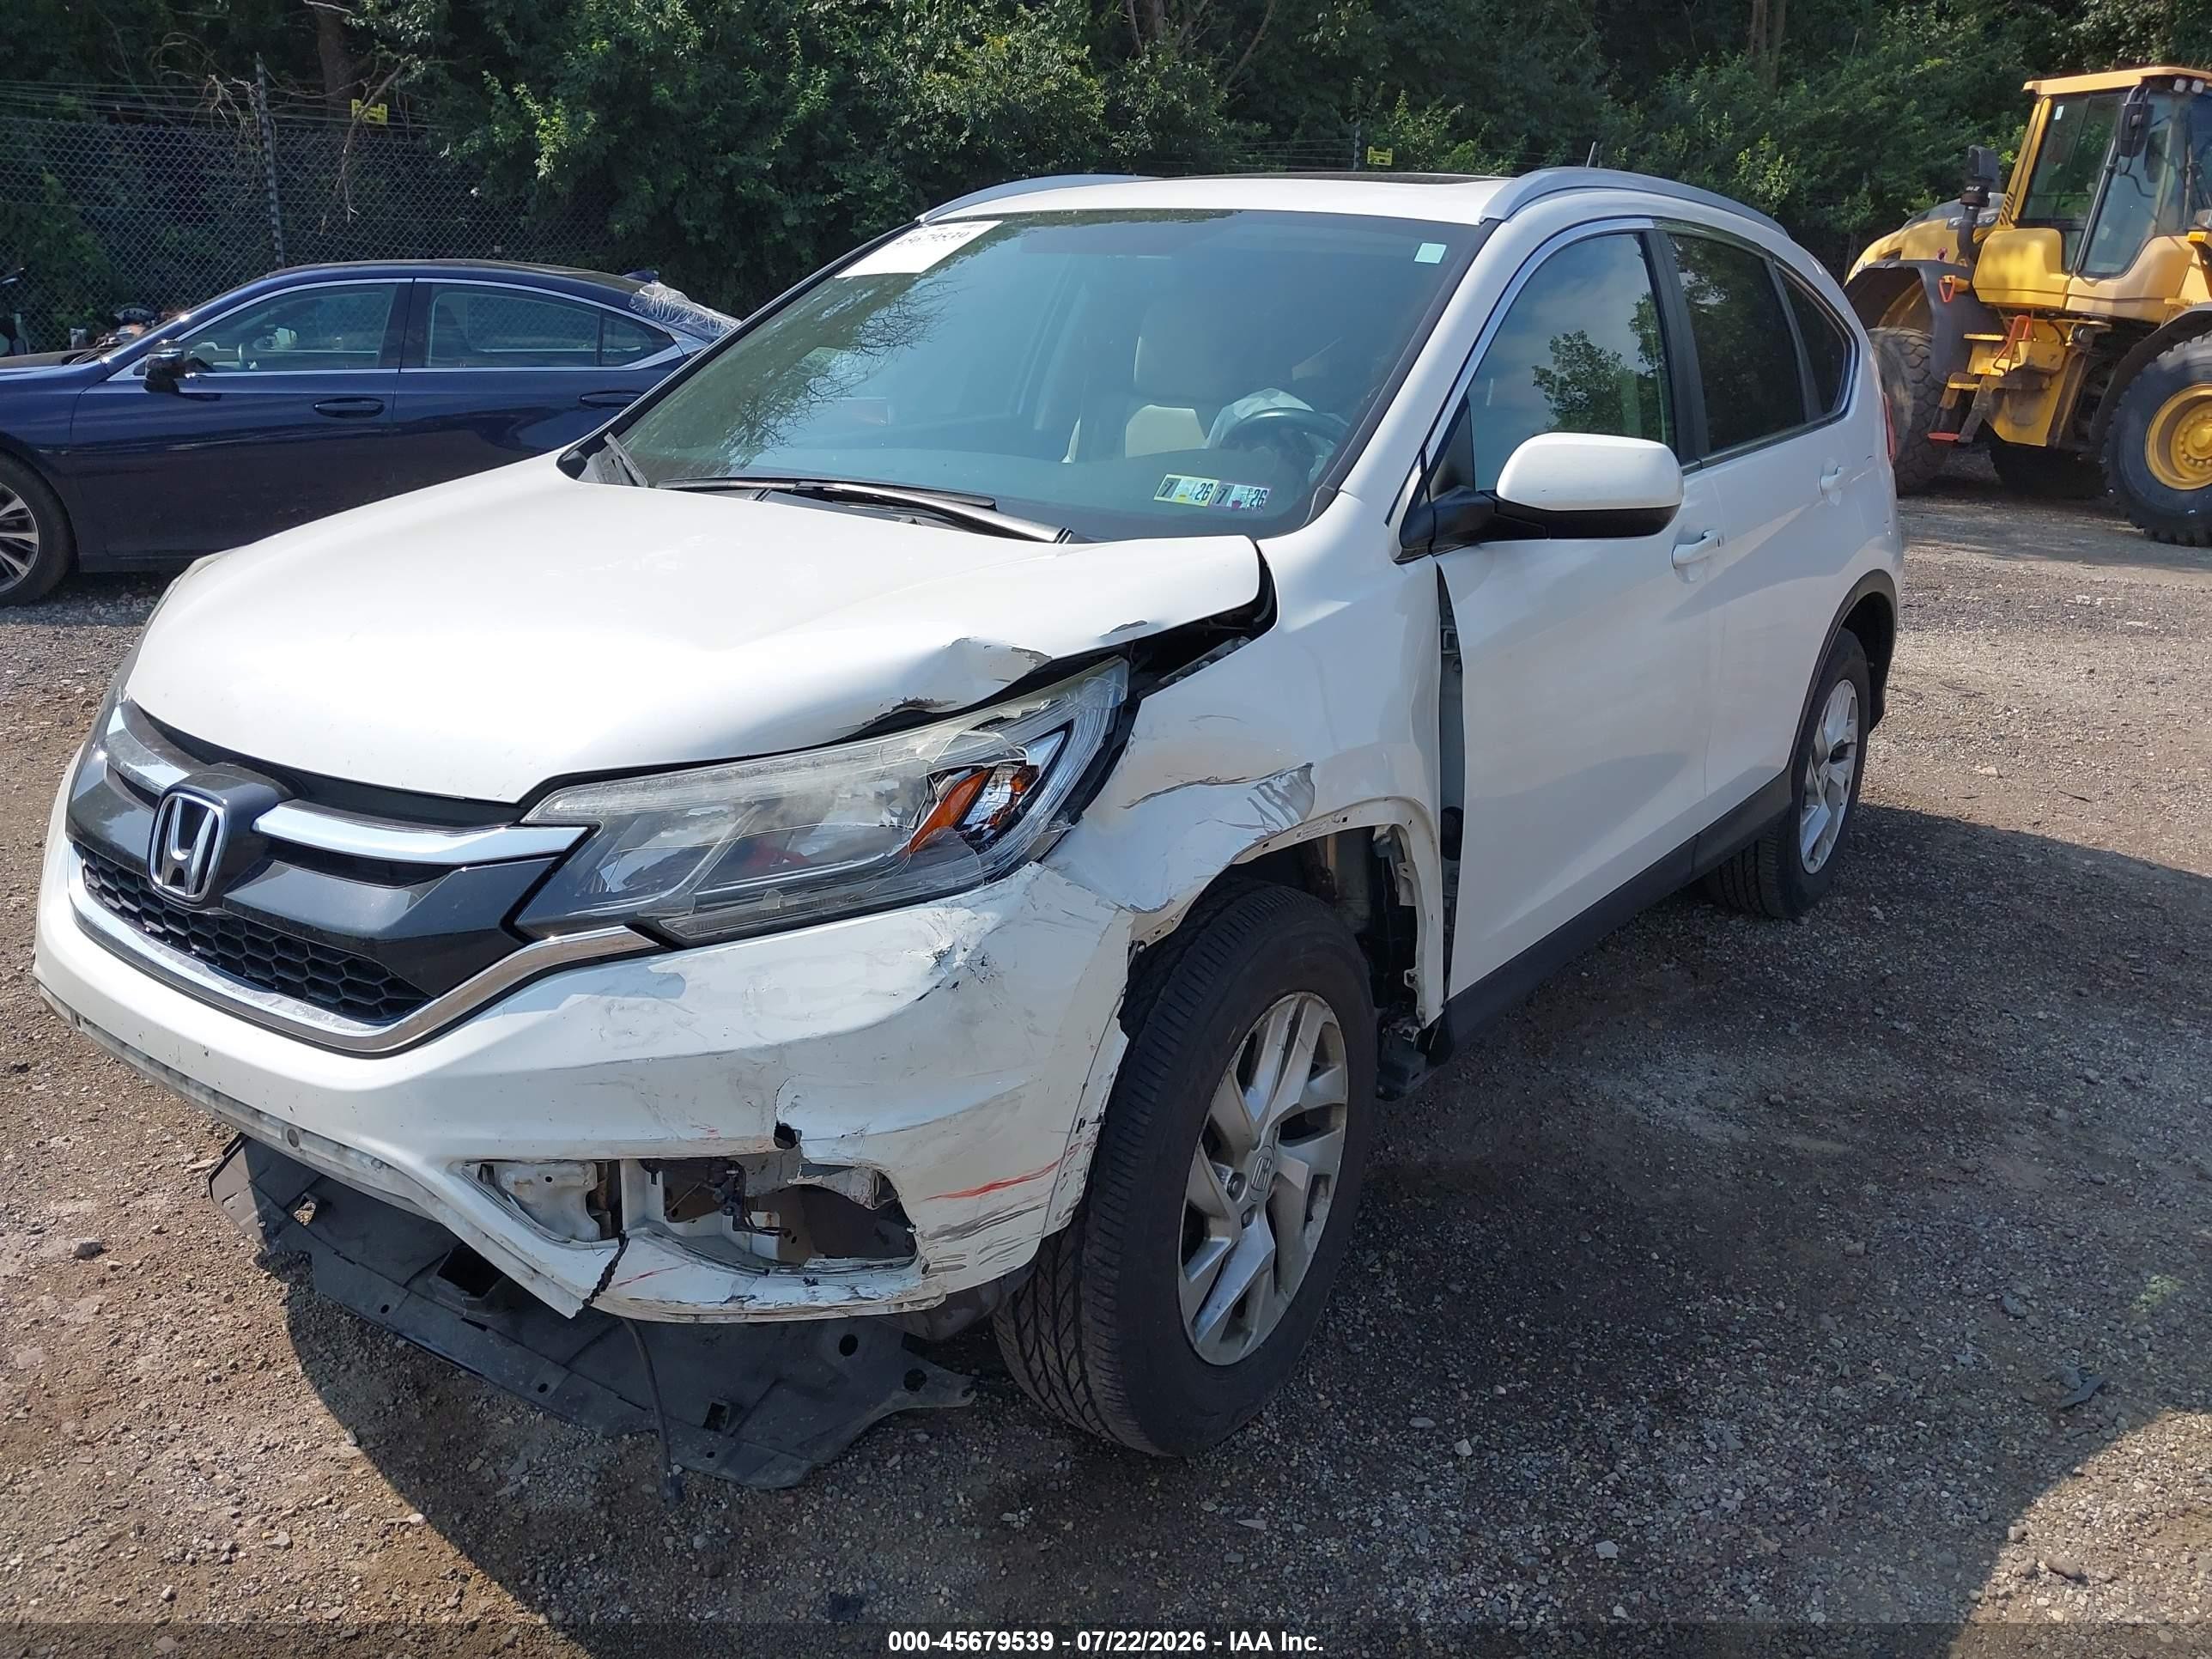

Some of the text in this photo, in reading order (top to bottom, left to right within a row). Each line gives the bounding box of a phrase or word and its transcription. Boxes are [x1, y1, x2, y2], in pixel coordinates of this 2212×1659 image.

[1161, 482, 1213, 501] 7 26
[1216, 488, 1229, 505] 7
[1249, 488, 1268, 508] 26
